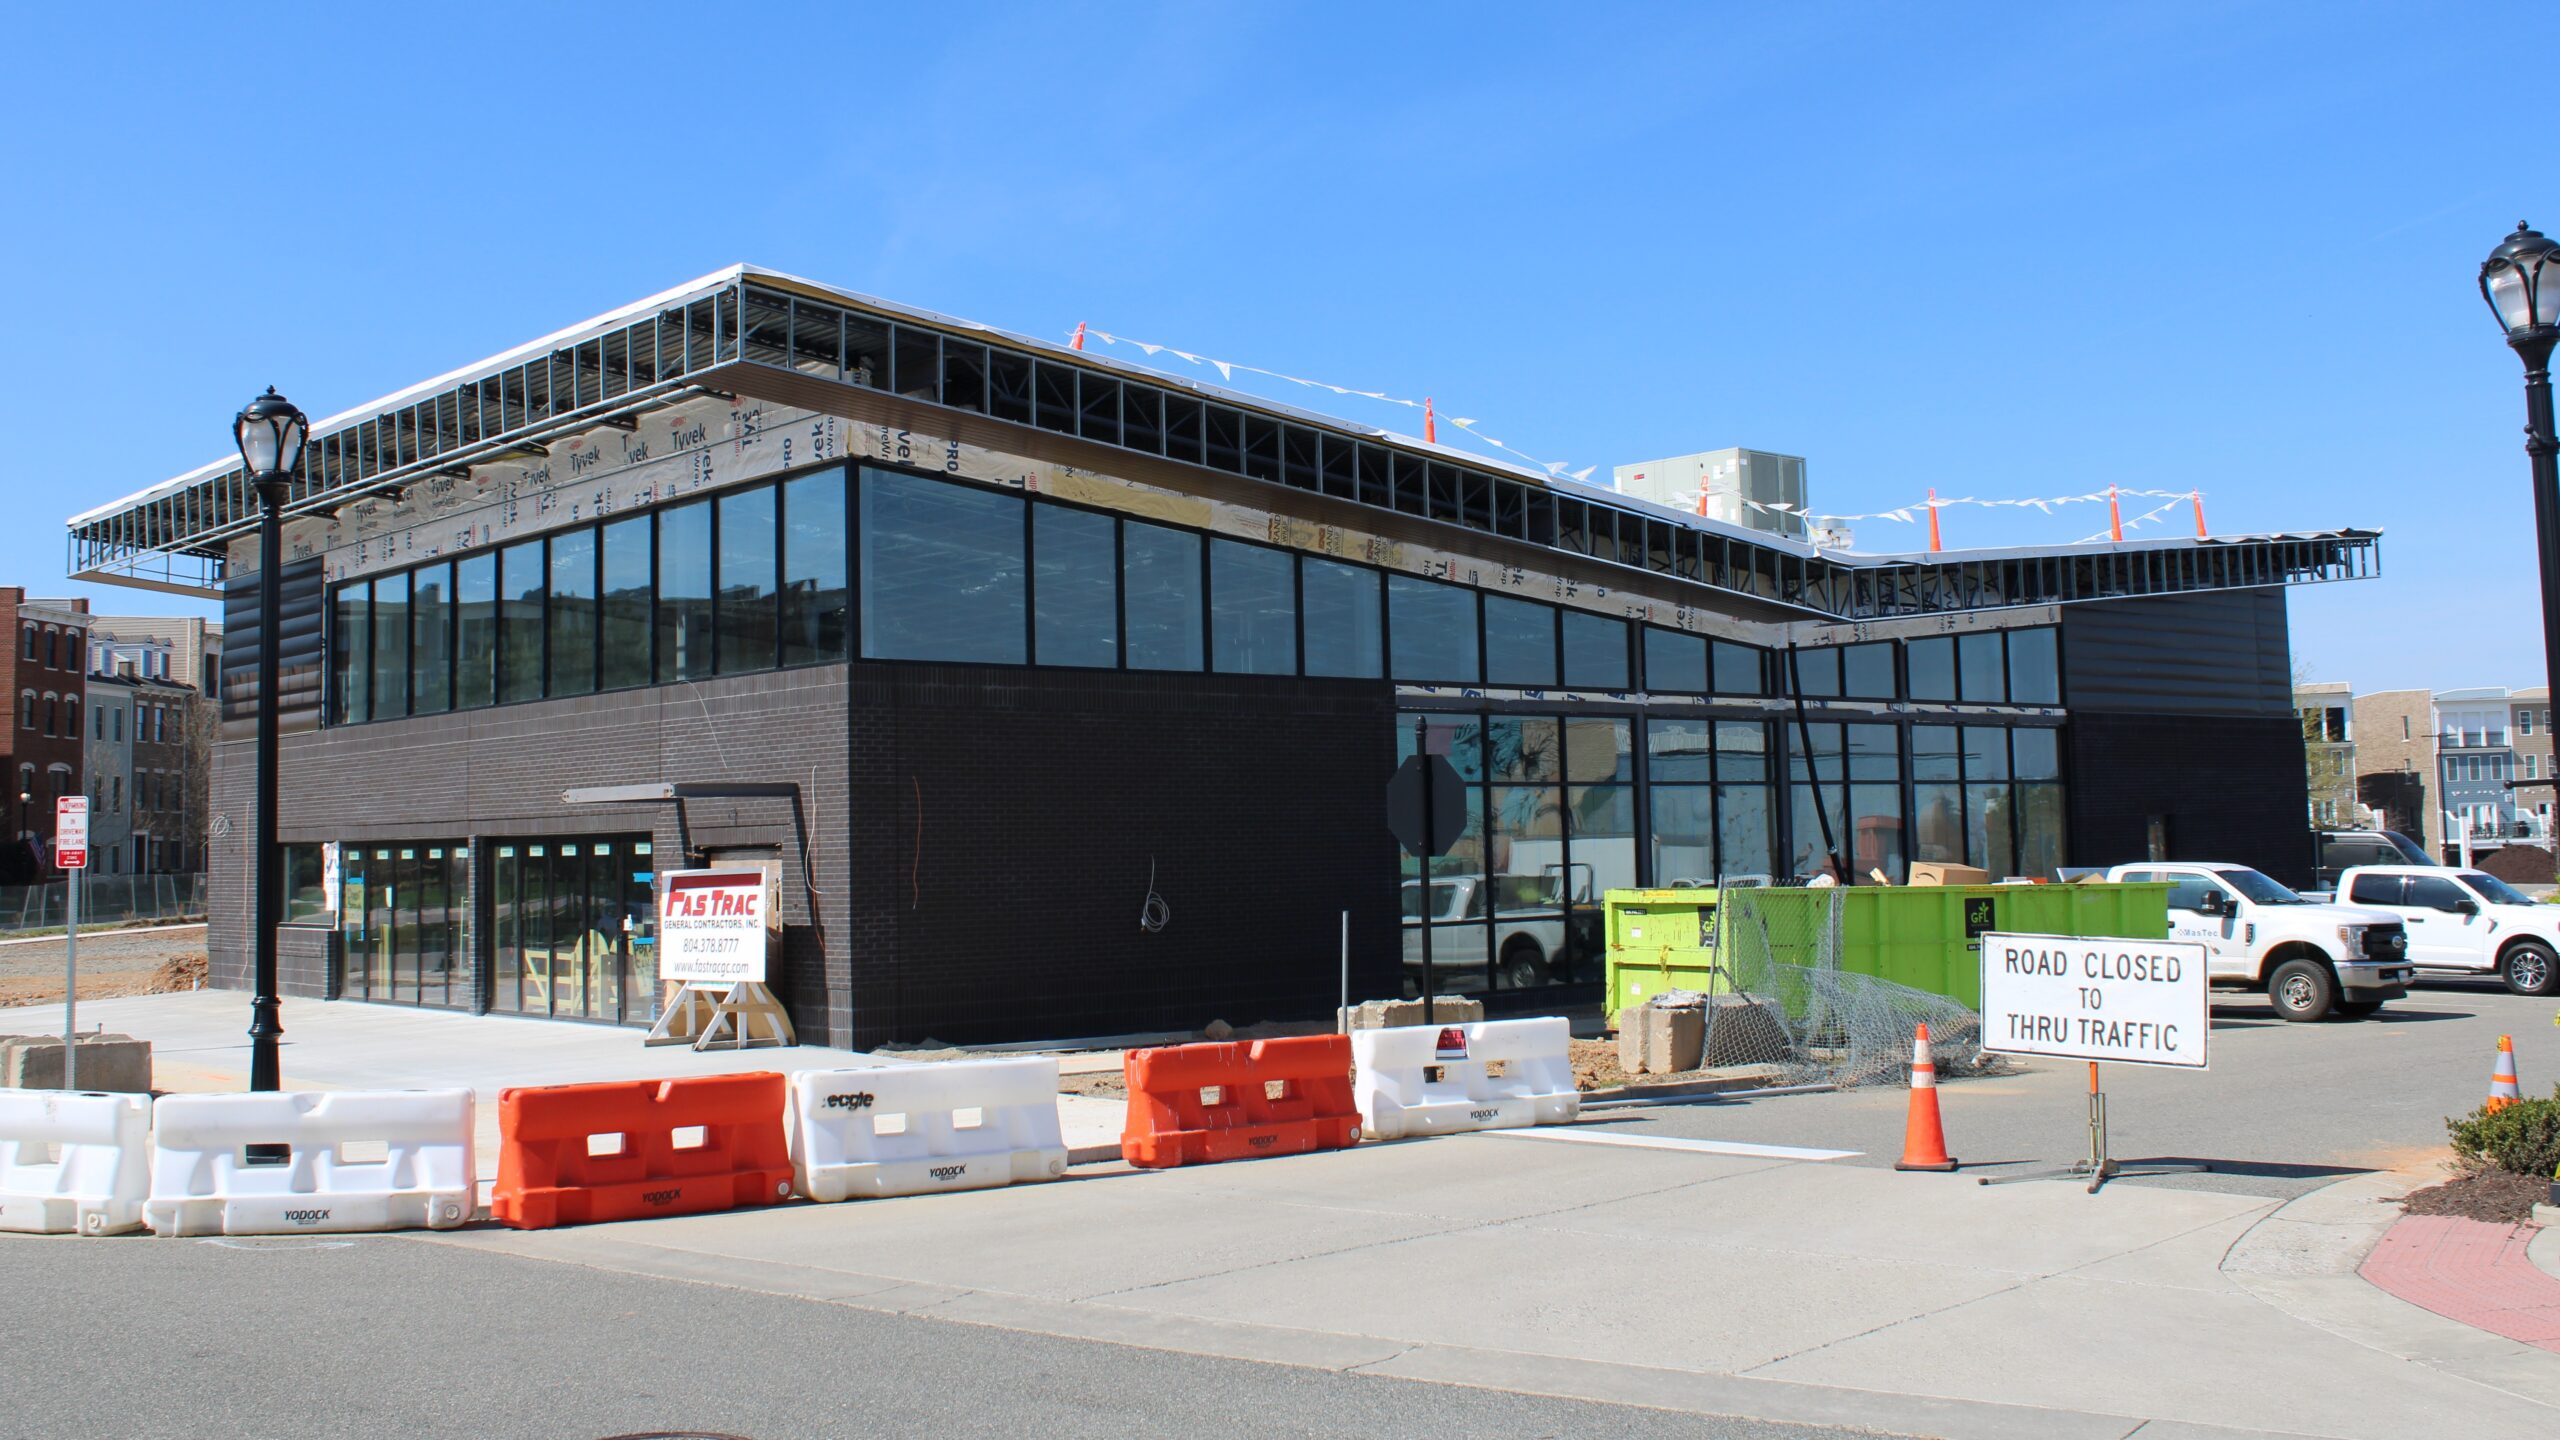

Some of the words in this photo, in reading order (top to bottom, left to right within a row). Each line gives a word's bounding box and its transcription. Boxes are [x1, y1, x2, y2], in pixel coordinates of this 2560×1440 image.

[672, 423, 707, 451] Tyvek
[570, 446, 601, 475] Tyvek
[431, 477, 456, 498] Tyvek
[60, 828, 84, 836] DRIVEWAY
[60, 838, 71, 846] FIRE
[72, 838, 85, 846] LANE
[664, 920, 692, 929] GENERAL
[694, 919, 744, 929] CONTRACTORS,
[746, 919, 760, 928] INC.
[1970, 910, 1989, 924] GFL
[1702, 920, 1715, 933] GF
[2184, 929, 2218, 937] MasTec
[683, 938, 739, 953] 804.378.8777
[674, 958, 749, 977] www.fastracgc.com
[2005, 948, 2067, 977] ROAD
[2084, 952, 2181, 983] CLOSED
[2078, 987, 2102, 1010] TO
[2007, 1014, 2068, 1043] THRU
[2078, 1018, 2178, 1051] TRAFFIC
[1470, 1108, 1499, 1119] YODOCK
[929, 1163, 967, 1178] YODOCK
[642, 1188, 682, 1203] YODOCK
[285, 1209, 331, 1221] YODOCK
